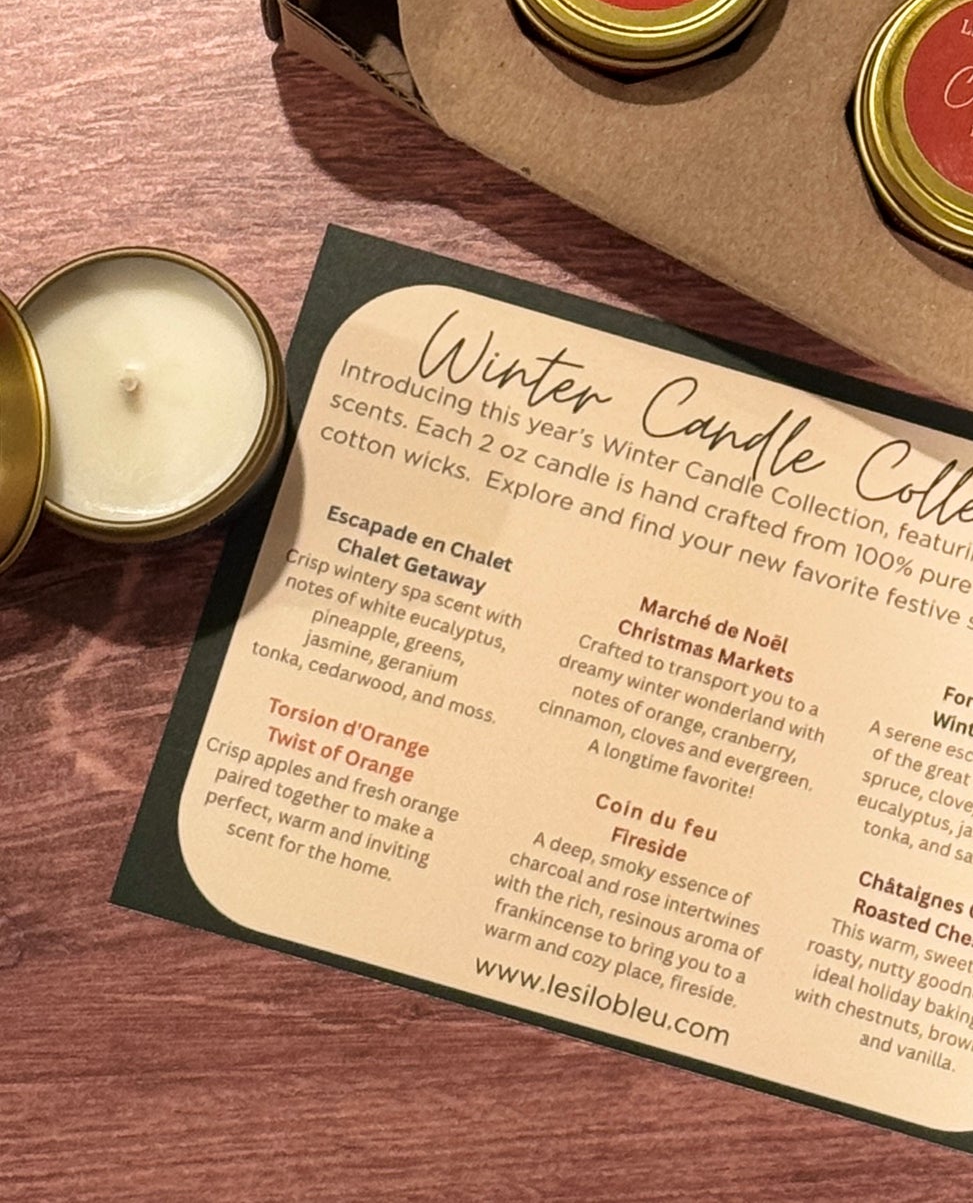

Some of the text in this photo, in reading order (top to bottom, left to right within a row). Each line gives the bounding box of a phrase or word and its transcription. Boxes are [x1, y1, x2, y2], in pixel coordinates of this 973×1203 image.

[418, 309, 612, 414] Winter
[641, 376, 825, 476] Candle
[339, 358, 473, 416] Introducing
[479, 399, 520, 427] this
[525, 416, 594, 448] year's
[603, 434, 680, 472] Winter
[684, 460, 764, 498] Candle
[770, 485, 888, 538] Collection,
[319, 425, 396, 459] cotton
[404, 448, 470, 482] wicks.
[485, 469, 573, 511] Explore
[578, 501, 625, 525] and
[629, 511, 676, 540] find
[678, 530, 734, 557] your
[737, 547, 786, 573] new
[792, 559, 879, 601] favorite
[885, 586, 961, 625] festive
[329, 393, 407, 428] scents.
[415, 414, 472, 447] Each
[477, 433, 494, 453] 2
[499, 443, 528, 463] oz
[533, 453, 610, 487] candle
[615, 472, 634, 494] is
[639, 479, 699, 513] hand
[703, 503, 788, 539] crafted
[792, 524, 846, 558] from
[854, 542, 913, 577] 100%
[918, 567, 972, 594] pure
[326, 504, 513, 573] Escapade en Chalet
[336, 536, 487, 596] Chalet Getaway
[285, 547, 522, 630] Crisp wintery spa scent with
[617, 618, 794, 683] Christmas Markets
[639, 595, 788, 654] Marché de Noël
[269, 696, 429, 759] Torsion d'Orange
[558, 653, 825, 744] dreamy winter wonderland with
[267, 725, 414, 783] Twist of Orange
[867, 719, 880, 735] A
[884, 726, 942, 753] serene
[205, 736, 459, 823] Crisp apples and fresh orange
[586, 738, 755, 799] A longtime favorite!
[595, 792, 717, 842] Coin du feu
[610, 825, 687, 862] Fireside
[493, 873, 764, 962] with the rich, resinous aroma of
[852, 896, 931, 934] Roasted
[858, 870, 964, 914] Châtaignes
[806, 939, 863, 970] roasty,
[867, 957, 915, 984] nutty
[475, 956, 729, 1046] www.lesilobleu.com
